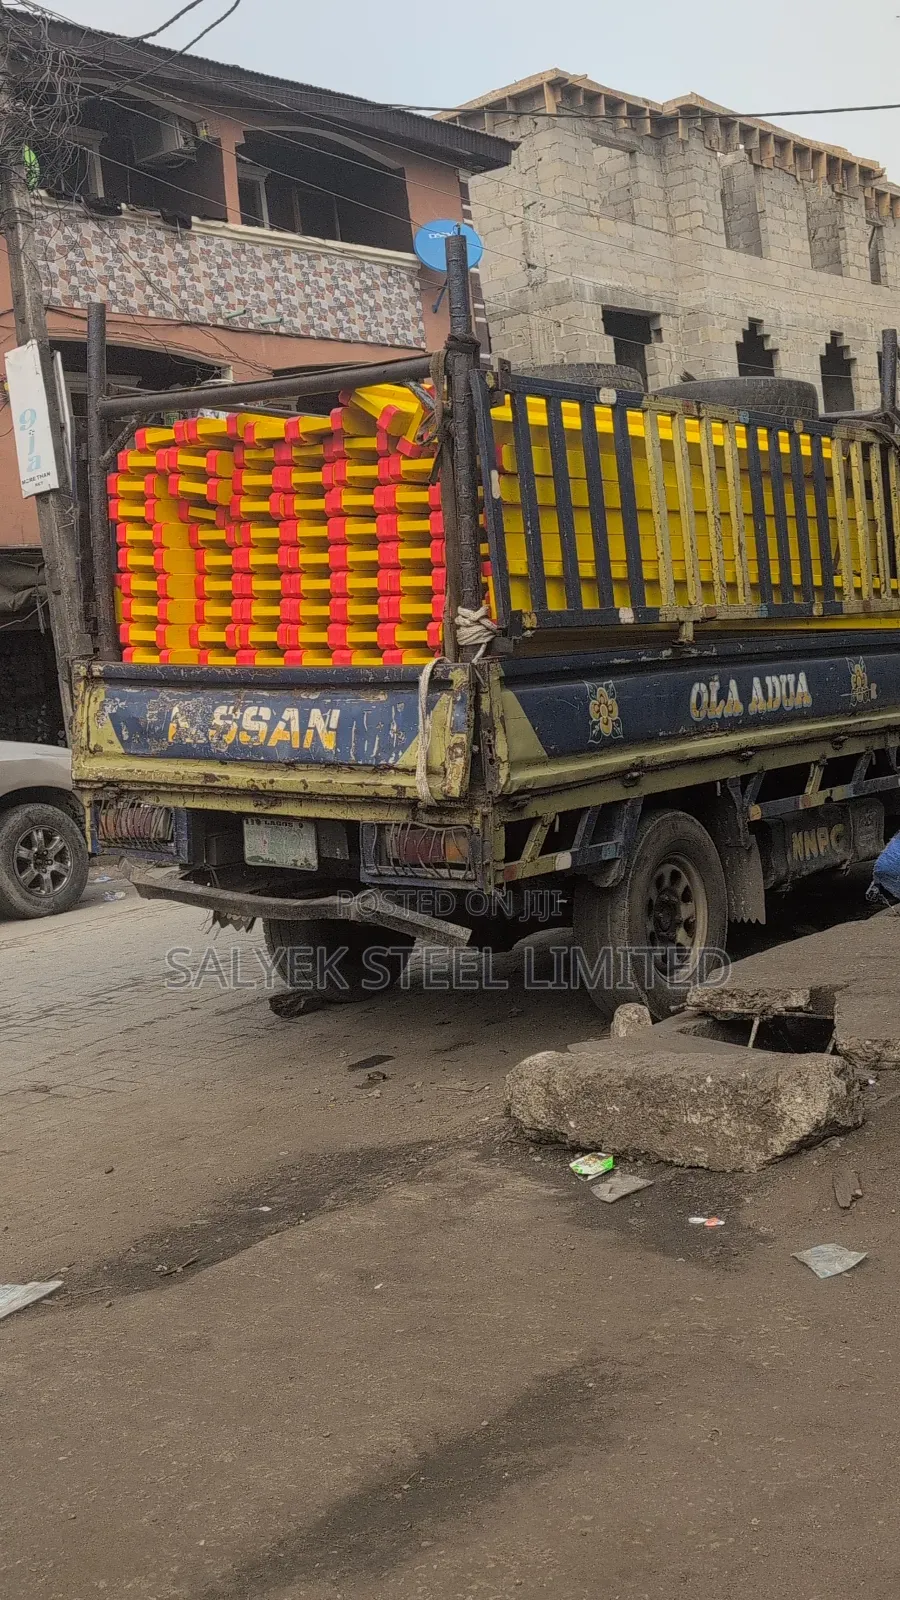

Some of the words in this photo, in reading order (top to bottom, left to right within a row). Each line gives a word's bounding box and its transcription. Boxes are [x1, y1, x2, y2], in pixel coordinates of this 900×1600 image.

[22, 476, 36, 485] MORE
[36, 471, 51, 480] THAN
[689, 679, 744, 721] OLA
[748, 671, 813, 715] ADUA
